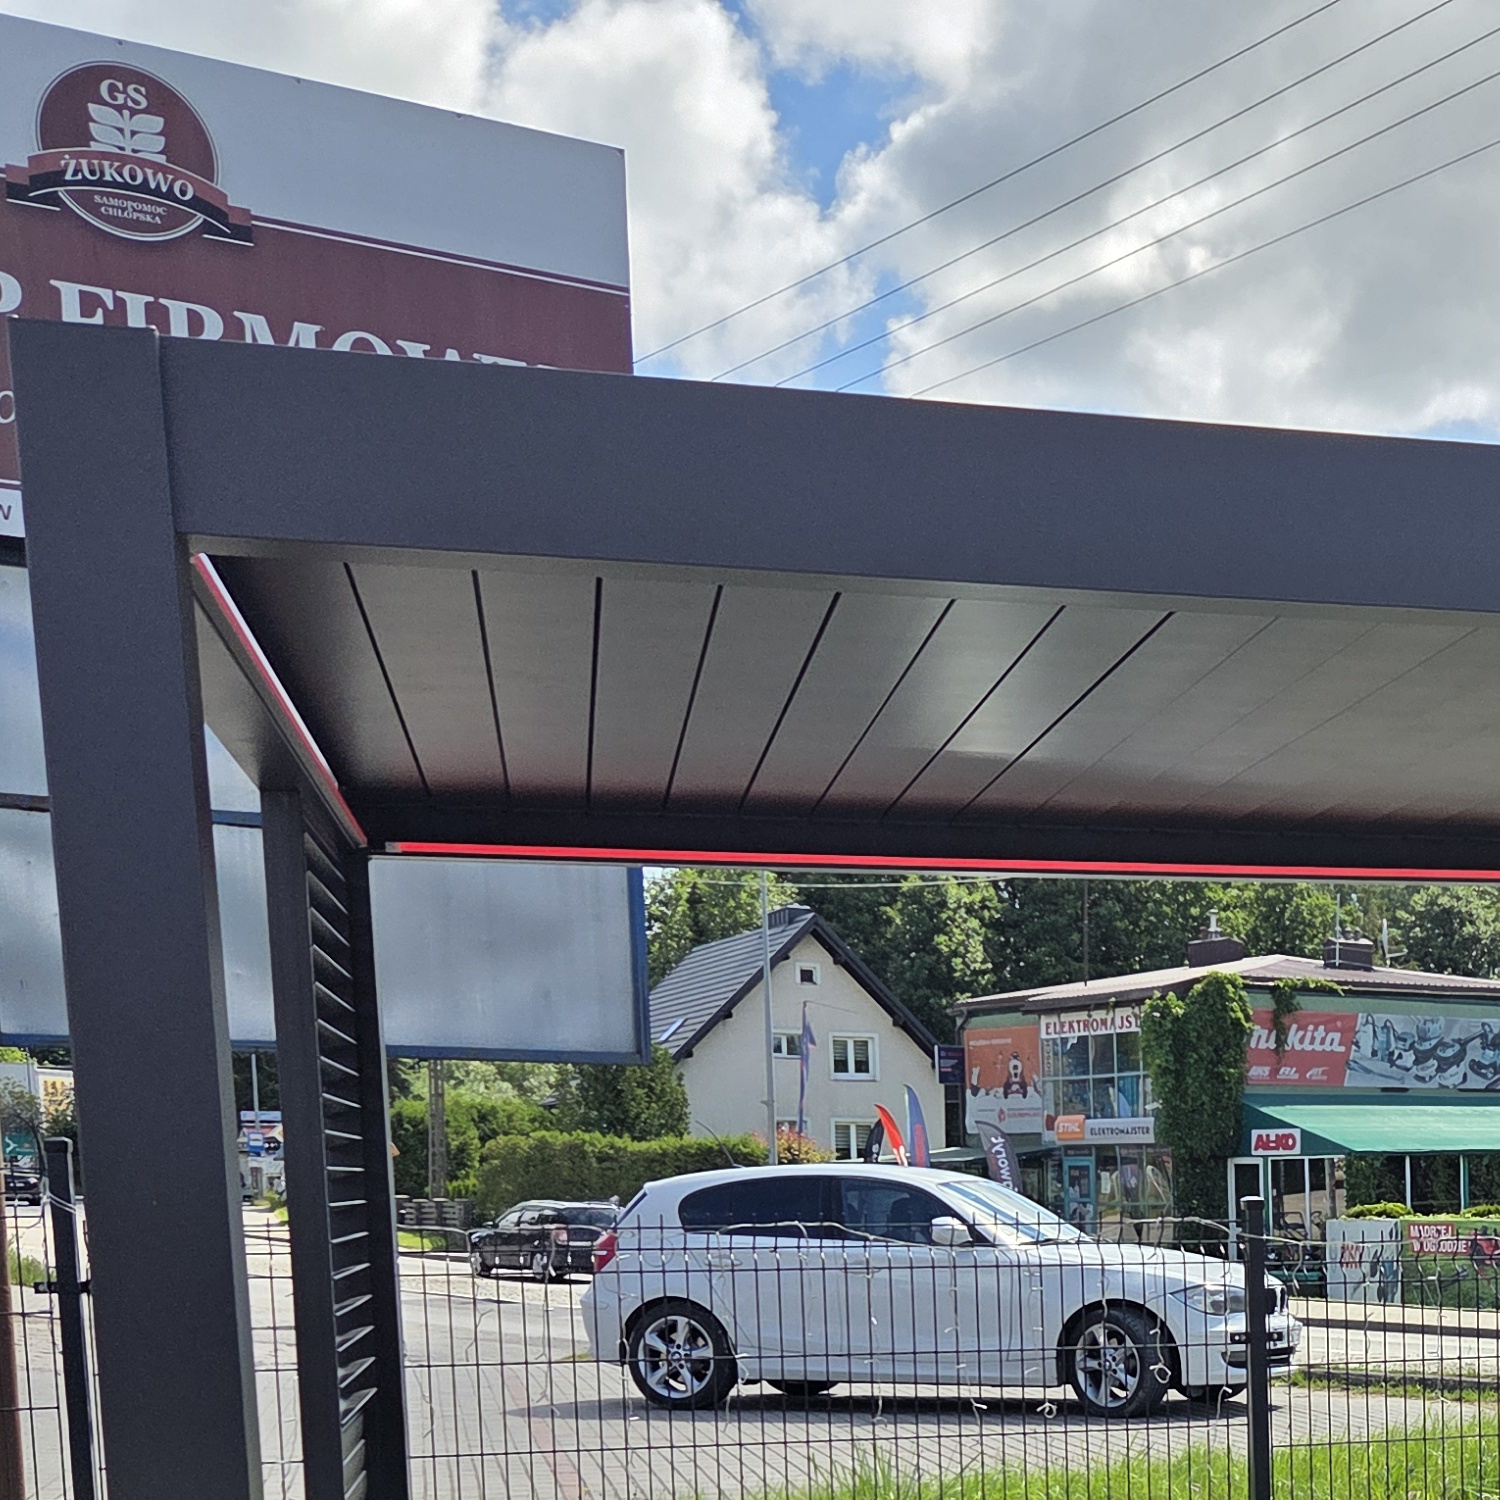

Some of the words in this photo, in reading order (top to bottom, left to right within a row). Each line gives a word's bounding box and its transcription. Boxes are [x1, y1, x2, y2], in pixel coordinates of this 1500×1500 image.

[100, 79, 148, 109] GS
[60, 155, 195, 200] ŻUKOWO
[94, 194, 168, 215] SAMOPOMOC
[1090, 1126, 1150, 1136] ELEKTROMAJSTER
